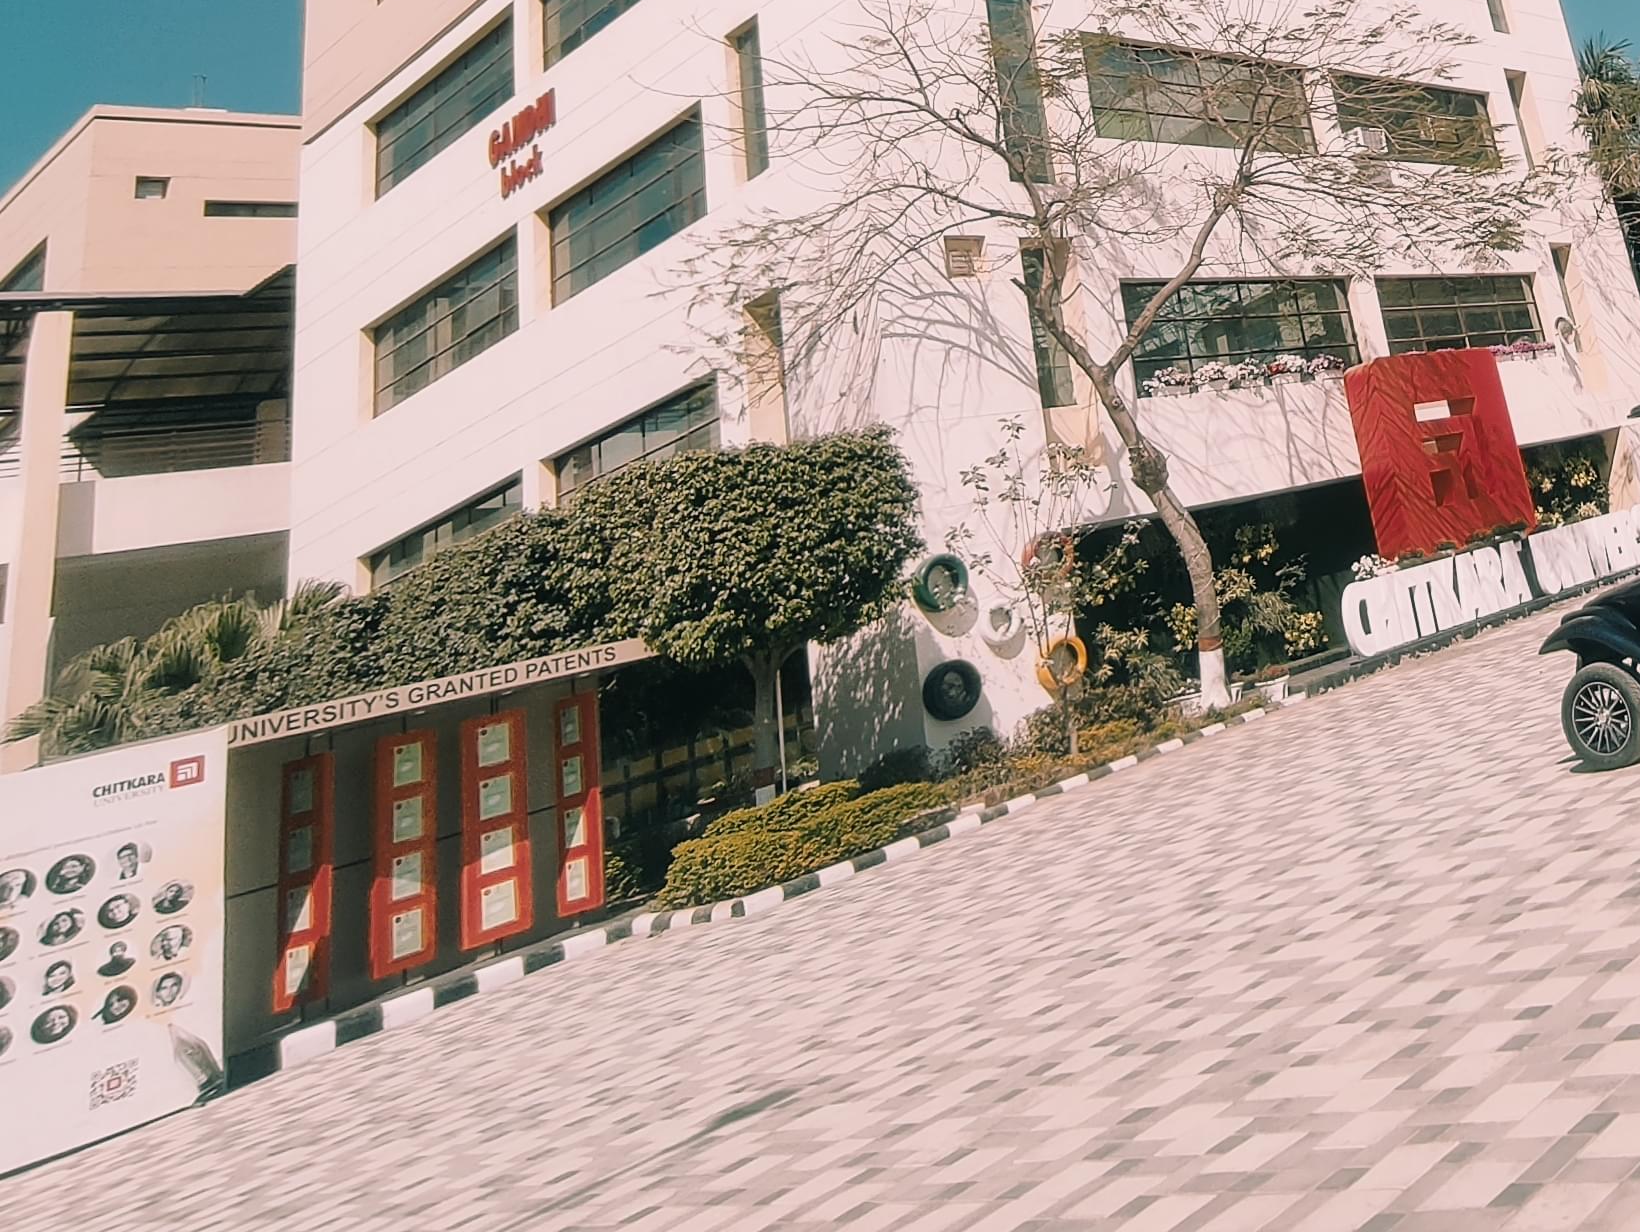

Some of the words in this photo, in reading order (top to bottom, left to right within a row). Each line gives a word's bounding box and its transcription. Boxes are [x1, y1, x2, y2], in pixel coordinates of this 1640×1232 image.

[408, 667, 518, 704] GRANTED
[525, 646, 616, 679] PATENTS
[92, 772, 165, 798] CHITKARA
[94, 785, 164, 807] UNIVERSITY
